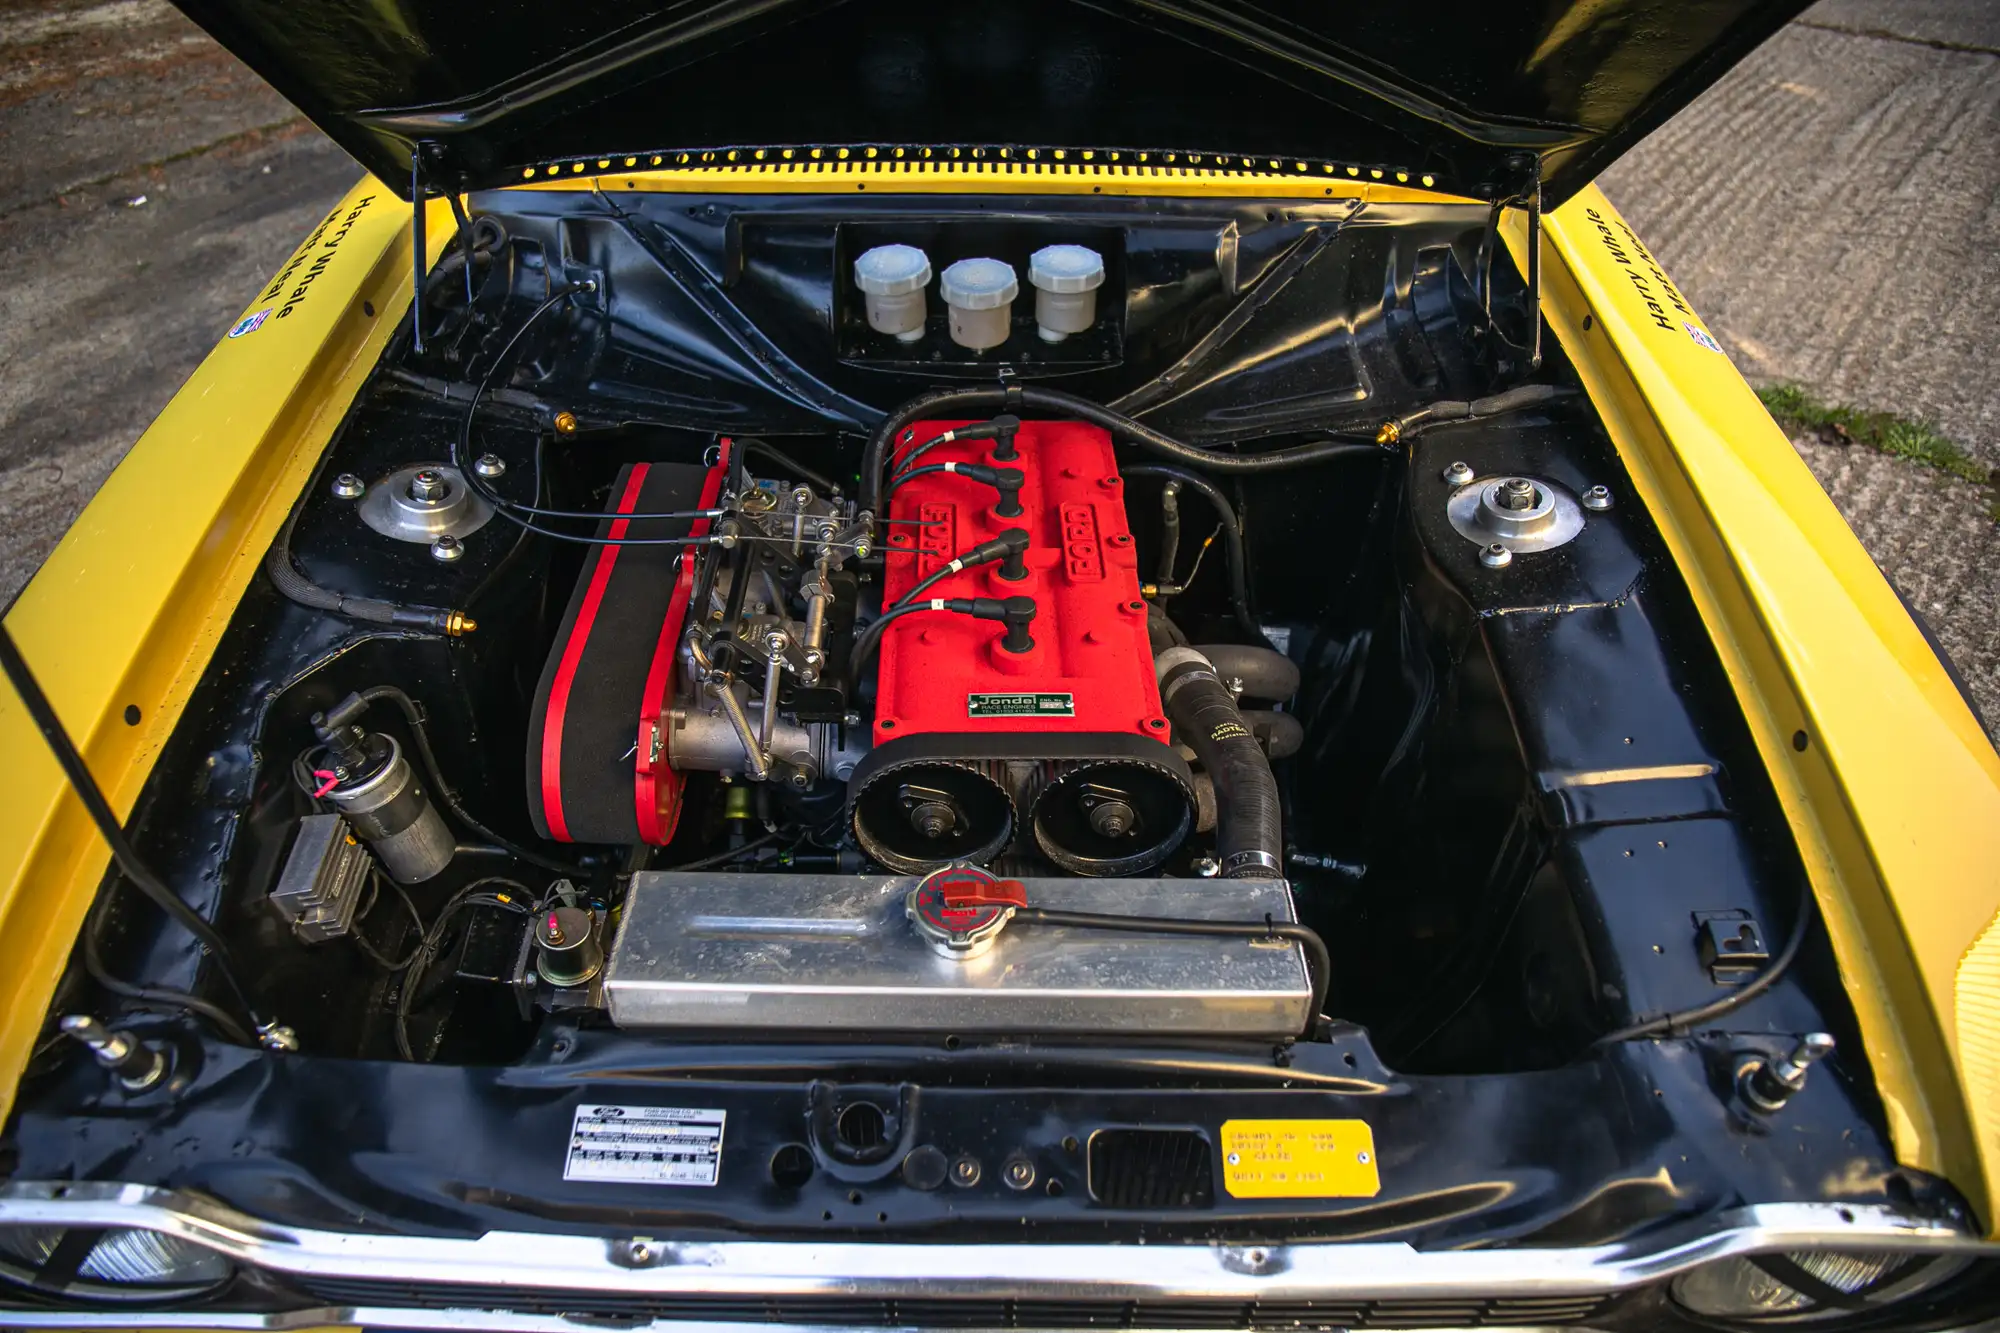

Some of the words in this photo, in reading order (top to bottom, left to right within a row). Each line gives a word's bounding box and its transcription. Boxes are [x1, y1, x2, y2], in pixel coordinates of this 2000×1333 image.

[324, 195, 376, 248] Harry
[1586, 208, 1632, 265] Whale
[1615, 221, 1654, 266] Neal
[261, 254, 308, 304] Neal
[276, 250, 336, 319] Whale
[1625, 268, 1677, 332] Harry
[1650, 267, 1691, 316] Matt
[1067, 509, 1096, 575] FORD
[978, 695, 1037, 704] Jondel
